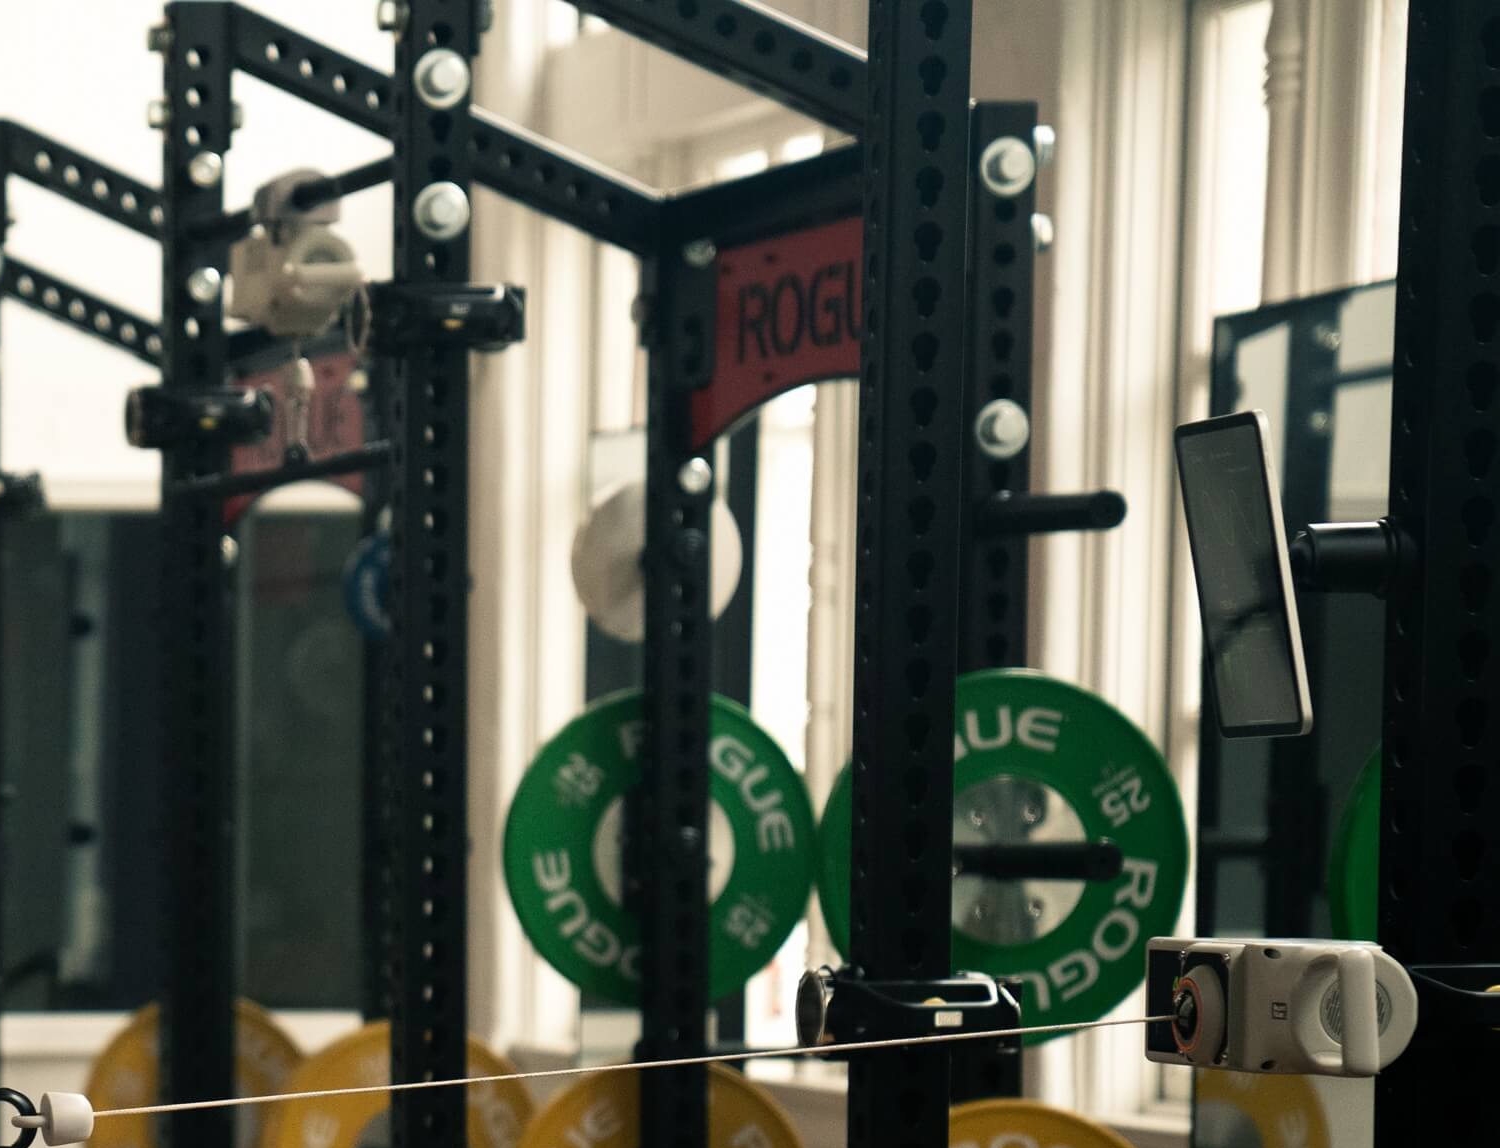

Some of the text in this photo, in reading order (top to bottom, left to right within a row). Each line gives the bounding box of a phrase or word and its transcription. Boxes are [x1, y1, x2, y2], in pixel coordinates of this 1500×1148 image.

[737, 260, 864, 365] ROGU
[1100, 774, 1151, 828] 25
[1020, 857, 1159, 1012] ROGU
